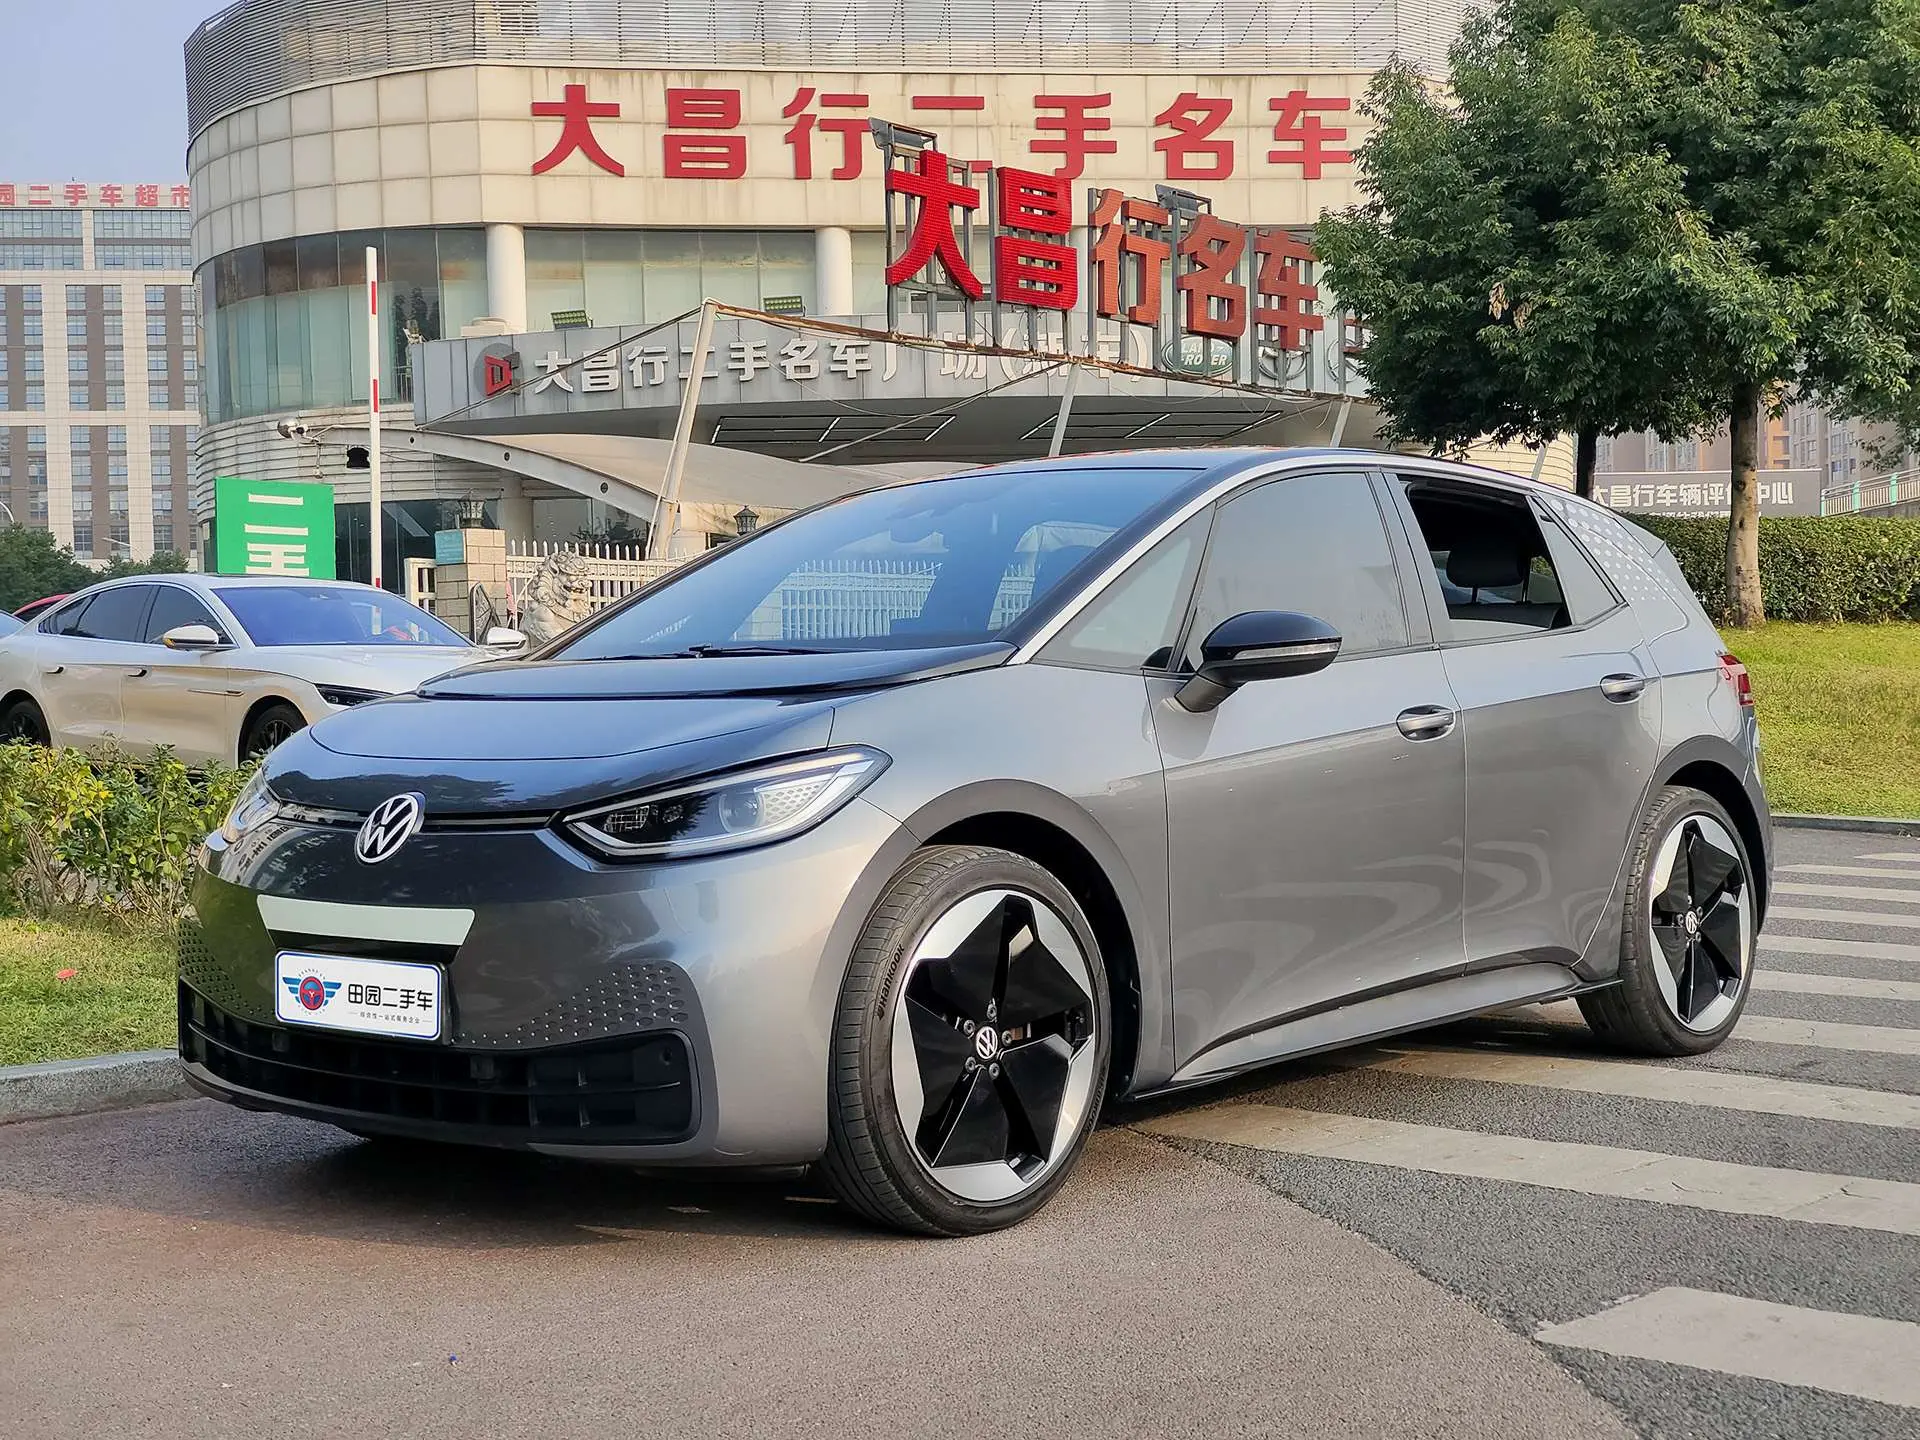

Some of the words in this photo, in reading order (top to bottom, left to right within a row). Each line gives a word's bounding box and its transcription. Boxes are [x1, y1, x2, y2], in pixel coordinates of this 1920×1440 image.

[532, 84, 1354, 181] 大昌行二手名车
[0, 183, 190, 207] 园二手车超市
[885, 150, 1324, 350] 大昌行名车
[1184, 354, 1228, 366] ROER
[347, 983, 433, 1011] 田园二手车
